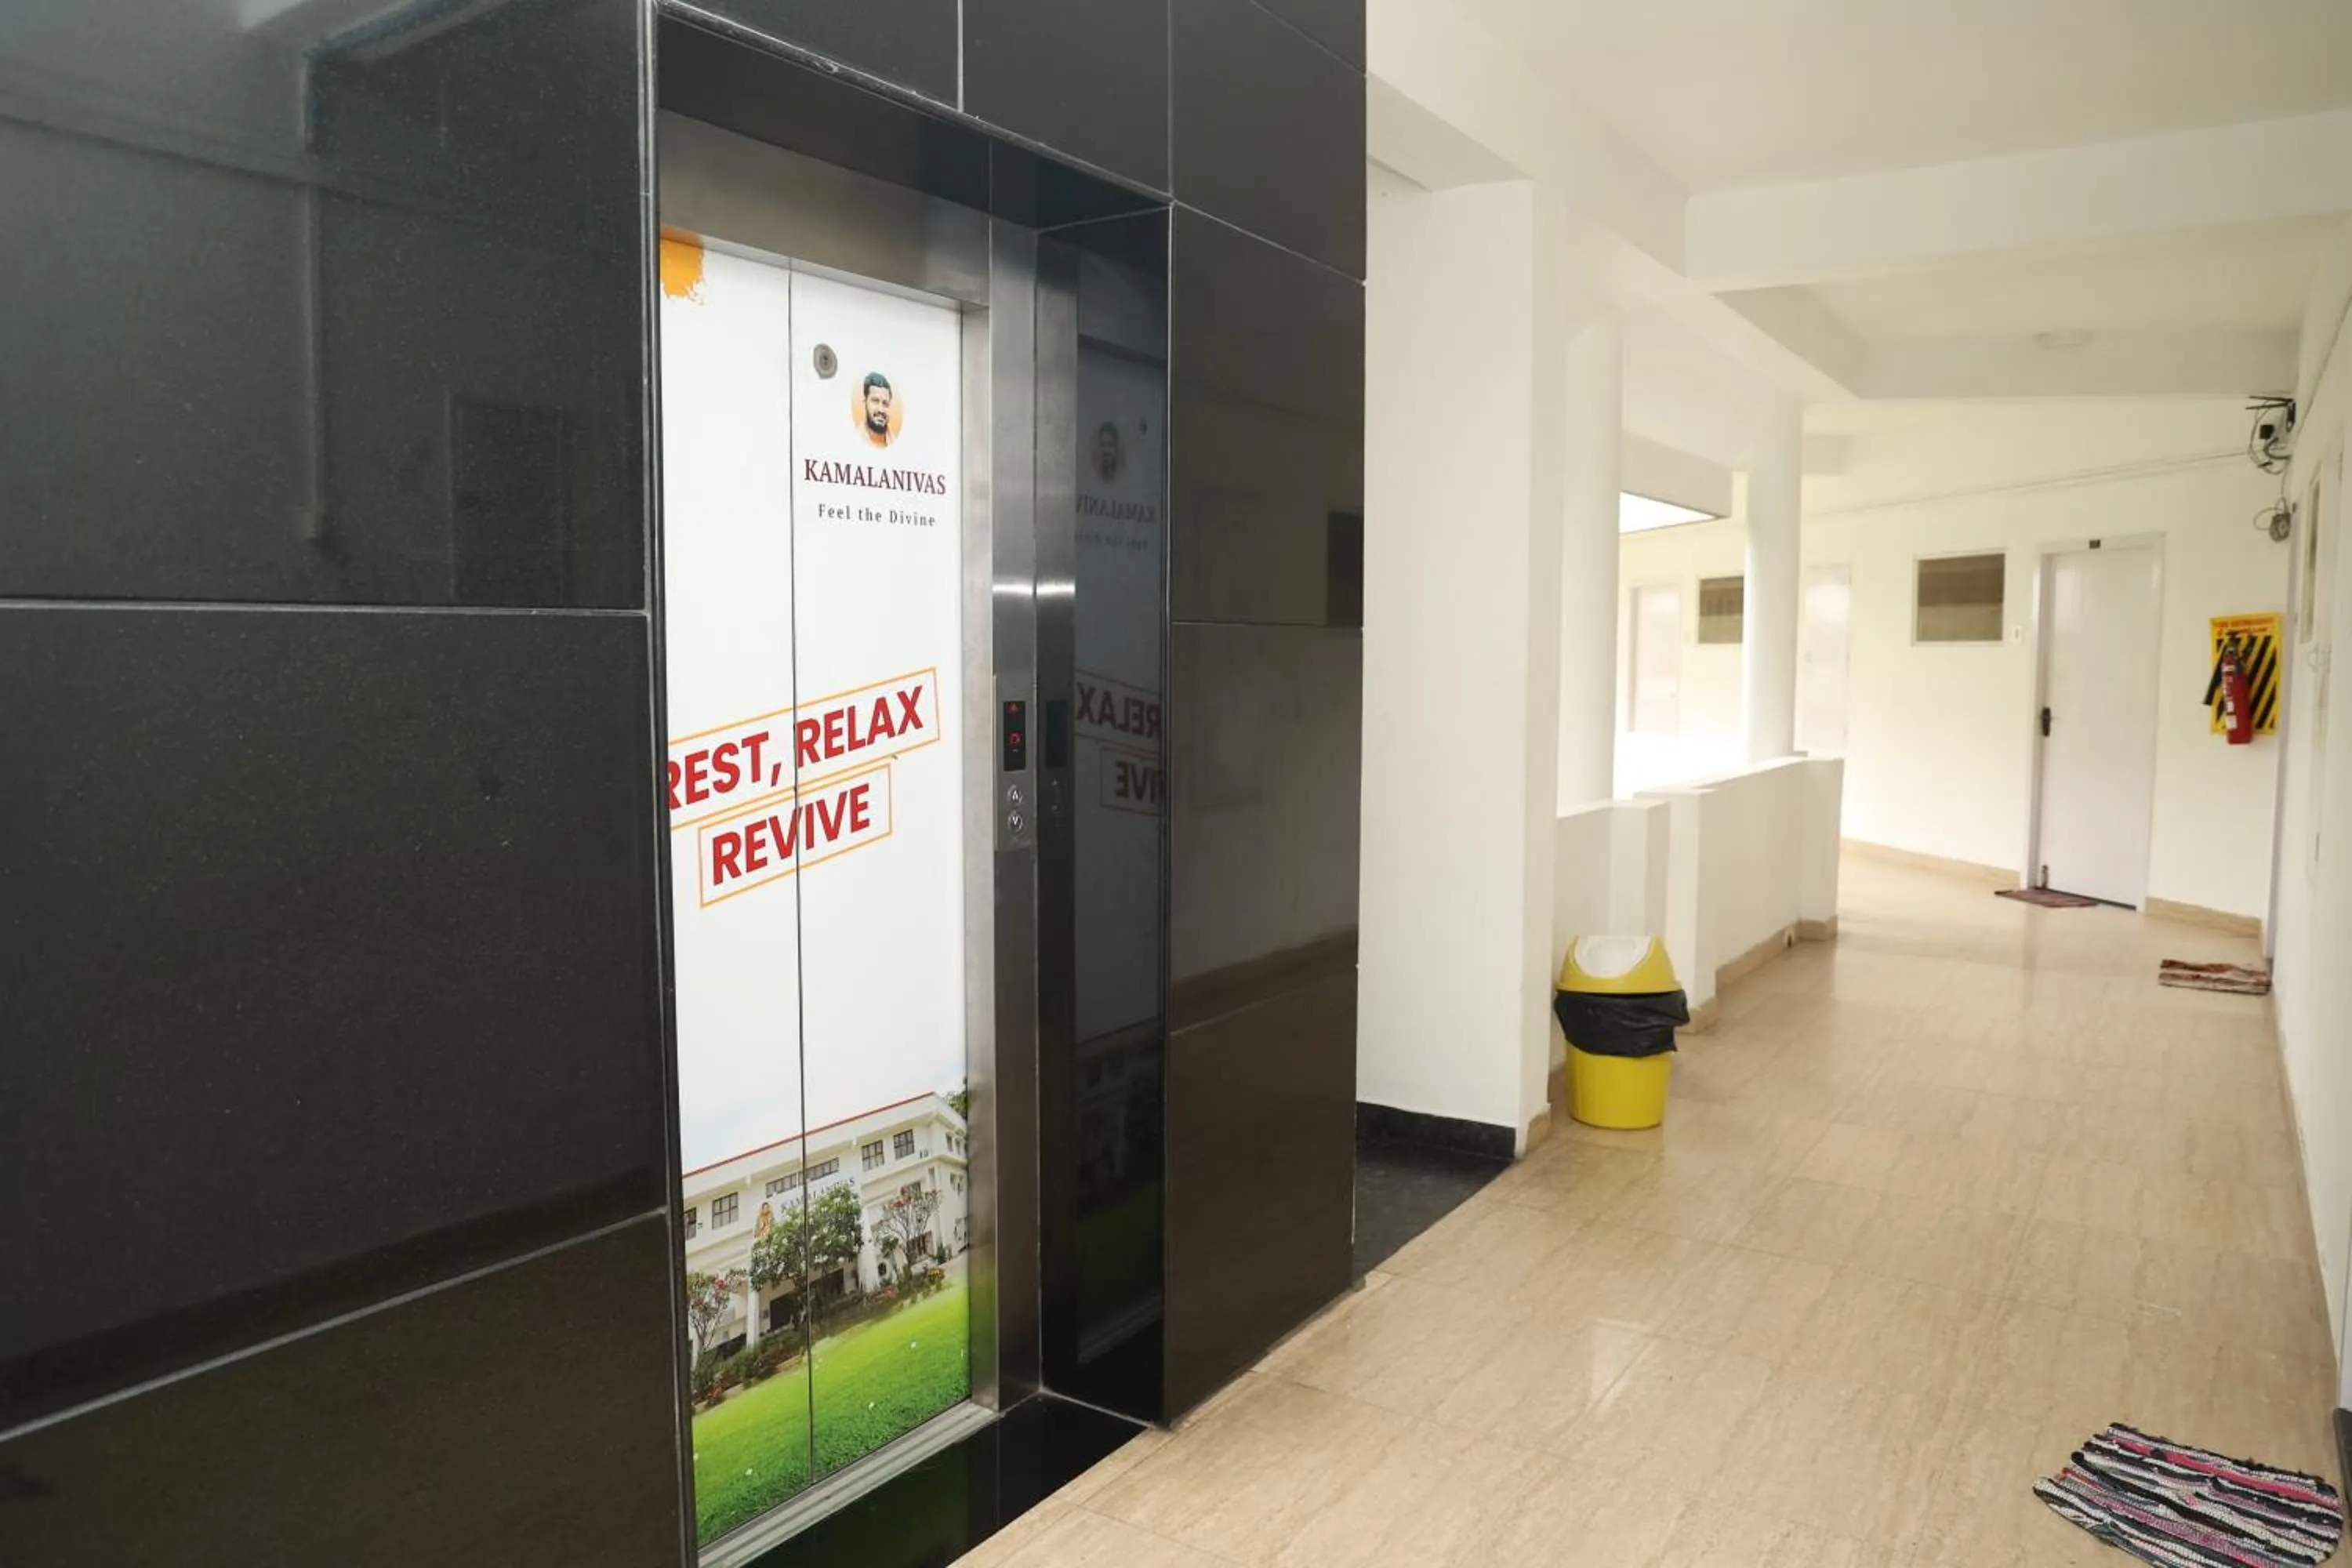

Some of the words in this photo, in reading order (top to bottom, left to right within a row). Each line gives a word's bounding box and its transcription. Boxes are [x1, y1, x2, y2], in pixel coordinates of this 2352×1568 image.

[804, 459, 946, 495] KAMALANIVAS
[818, 503, 851, 521] Feel
[858, 507, 882, 524] the
[890, 510, 936, 528] Divine
[797, 684, 924, 768] RELAX
[712, 782, 870, 886] REVIVE
